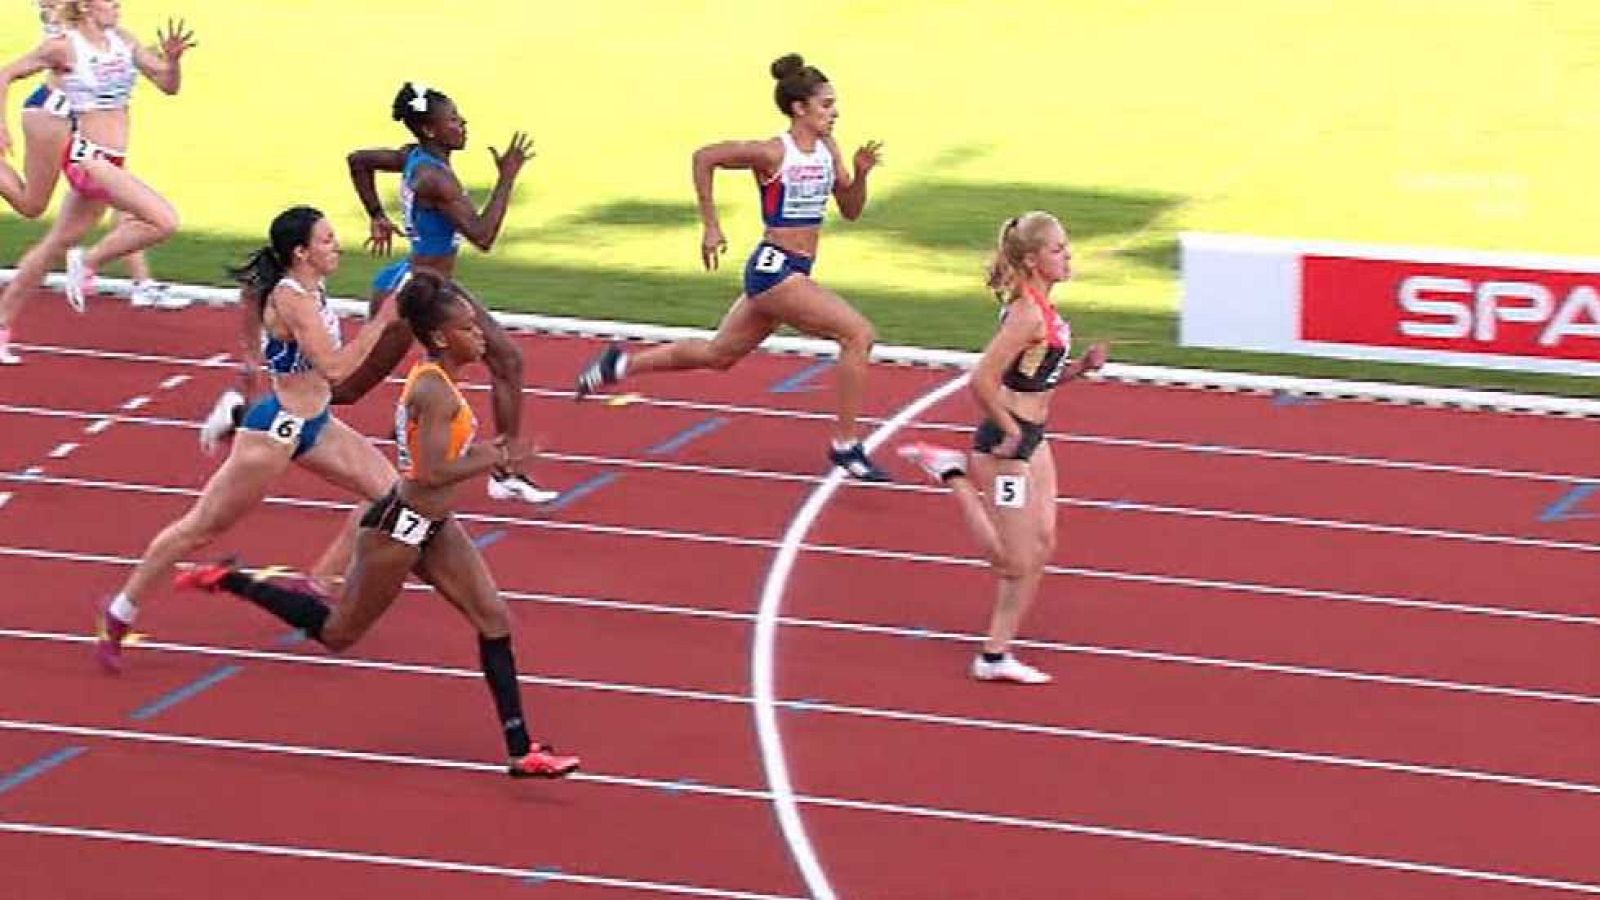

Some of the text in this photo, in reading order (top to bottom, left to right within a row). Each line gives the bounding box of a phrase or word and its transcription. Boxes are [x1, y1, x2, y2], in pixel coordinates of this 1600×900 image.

[76, 139, 87, 157] 2
[762, 249, 776, 266] 3
[1398, 282, 1600, 345] SPA
[276, 420, 293, 438] 6
[1001, 481, 1016, 502] 5
[402, 513, 419, 535] 7
